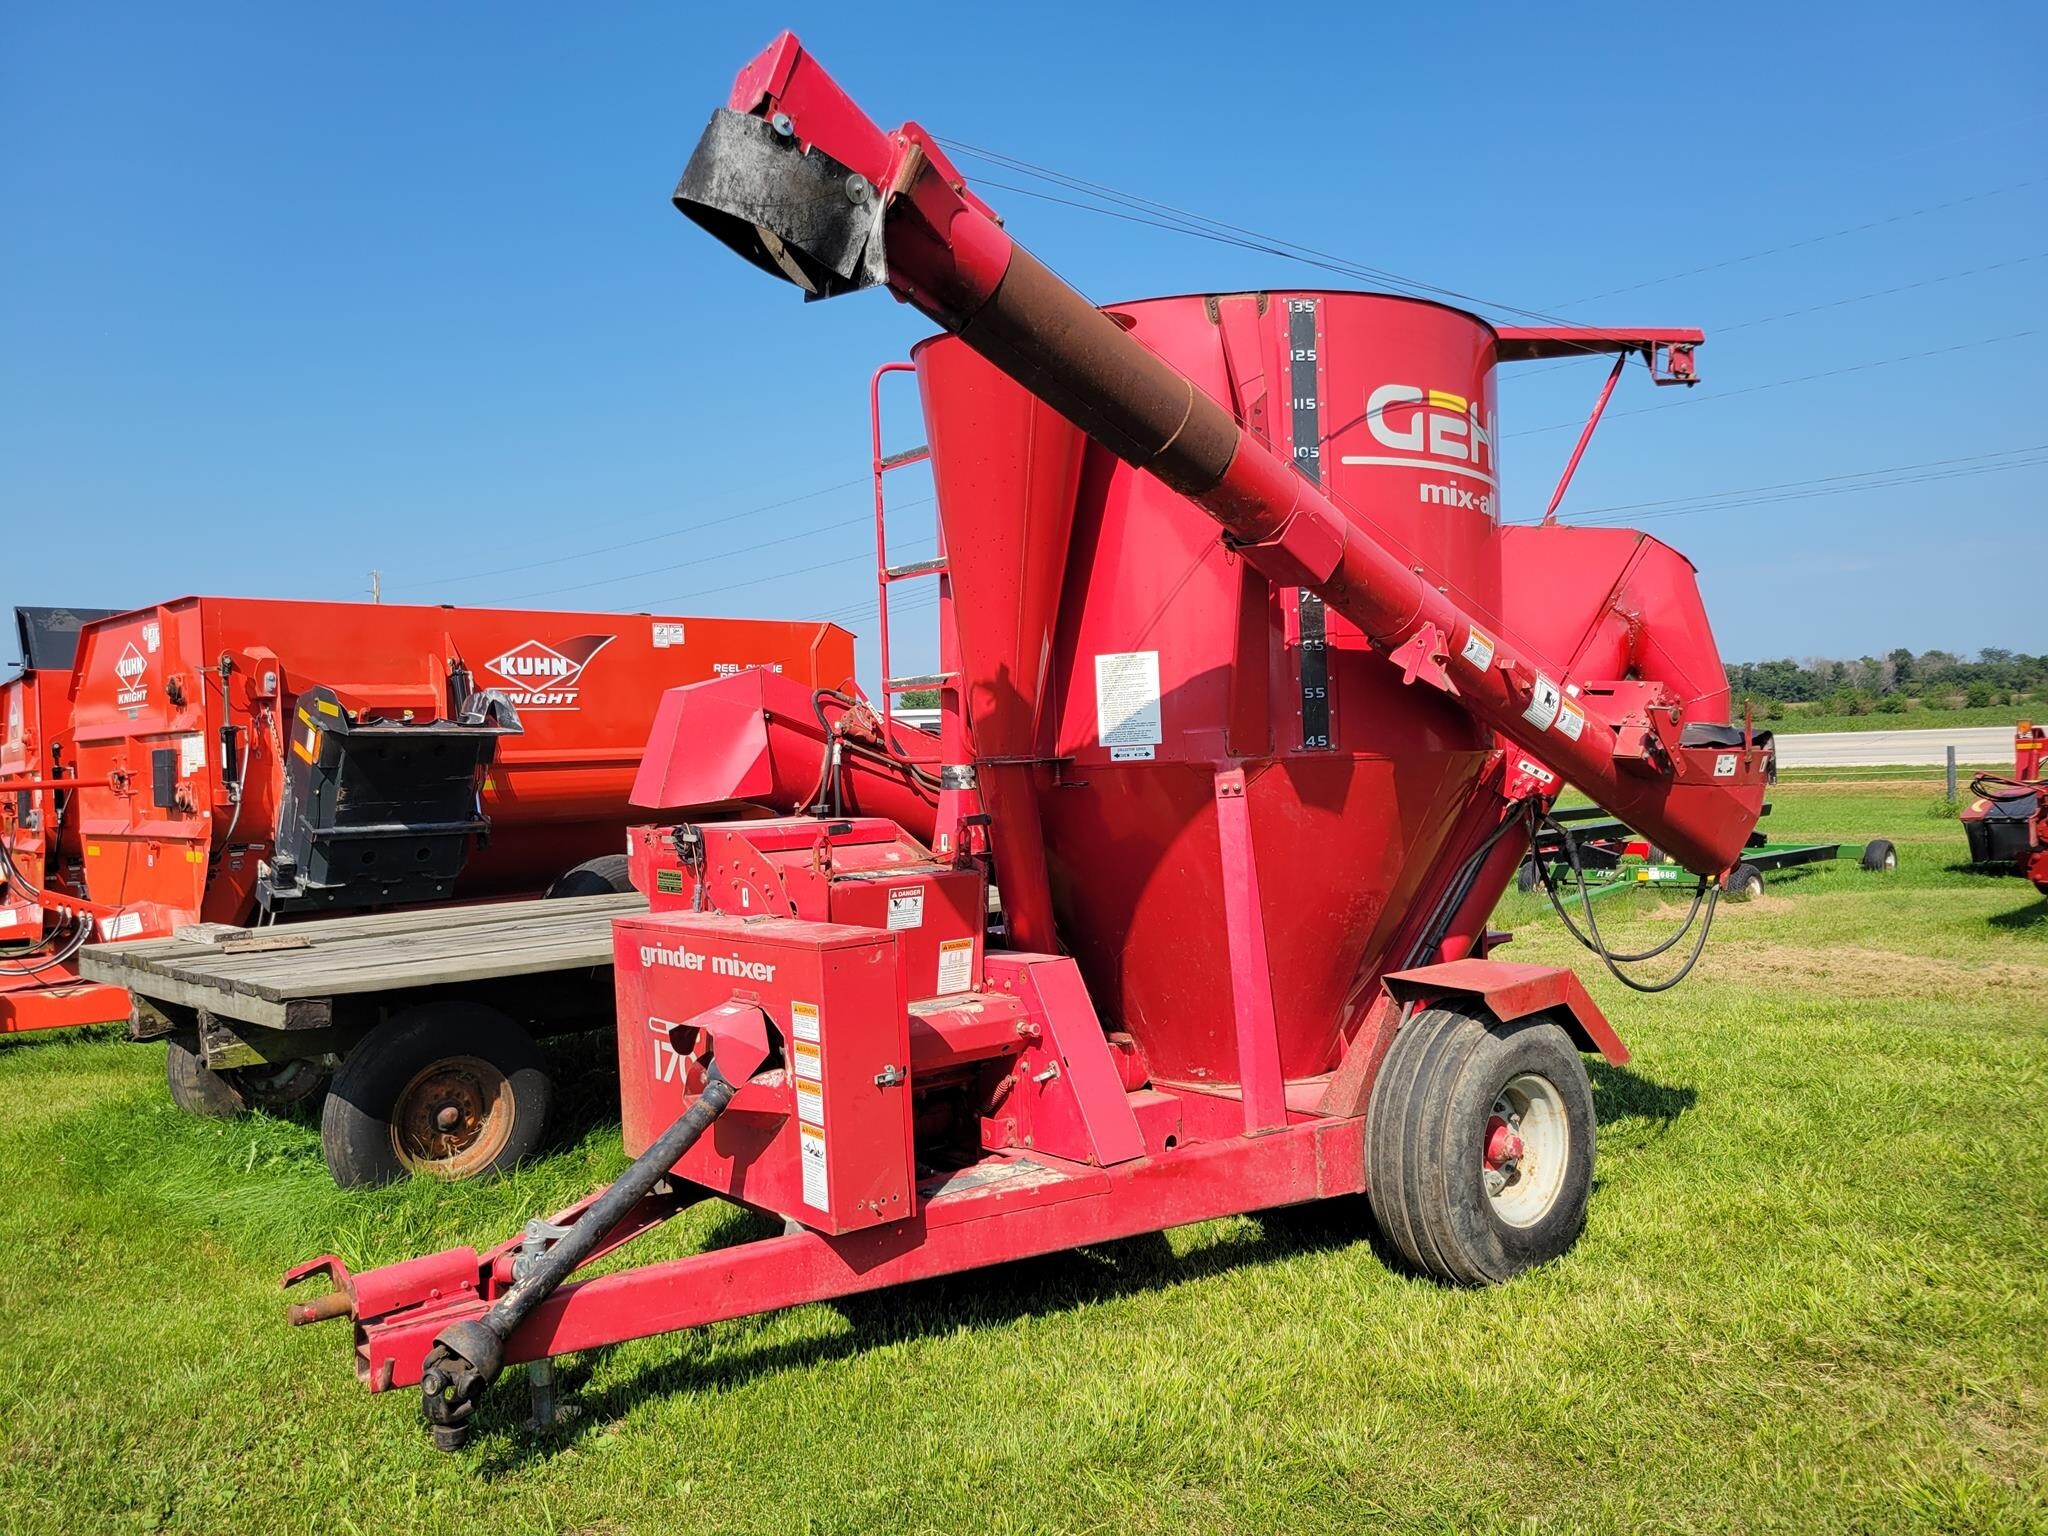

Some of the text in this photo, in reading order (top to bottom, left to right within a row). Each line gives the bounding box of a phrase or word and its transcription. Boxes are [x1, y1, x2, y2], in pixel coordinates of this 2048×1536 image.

[1288, 301, 1315, 313] 135
[1290, 349, 1317, 361] 125
[1293, 398, 1316, 410] 115
[1293, 446, 1320, 458] 105
[1302, 639, 1324, 651] 65
[119, 656, 144, 678] KUHN
[499, 656, 568, 676] KUHN
[712, 663, 740, 673] REEL
[117, 689, 148, 705] KNIGHT
[508, 692, 578, 705] NIGHT
[1304, 687, 1326, 699] 55
[1305, 735, 1328, 747] 45
[898, 888, 921, 898] DANGER
[639, 941, 777, 983] grinder mixer
